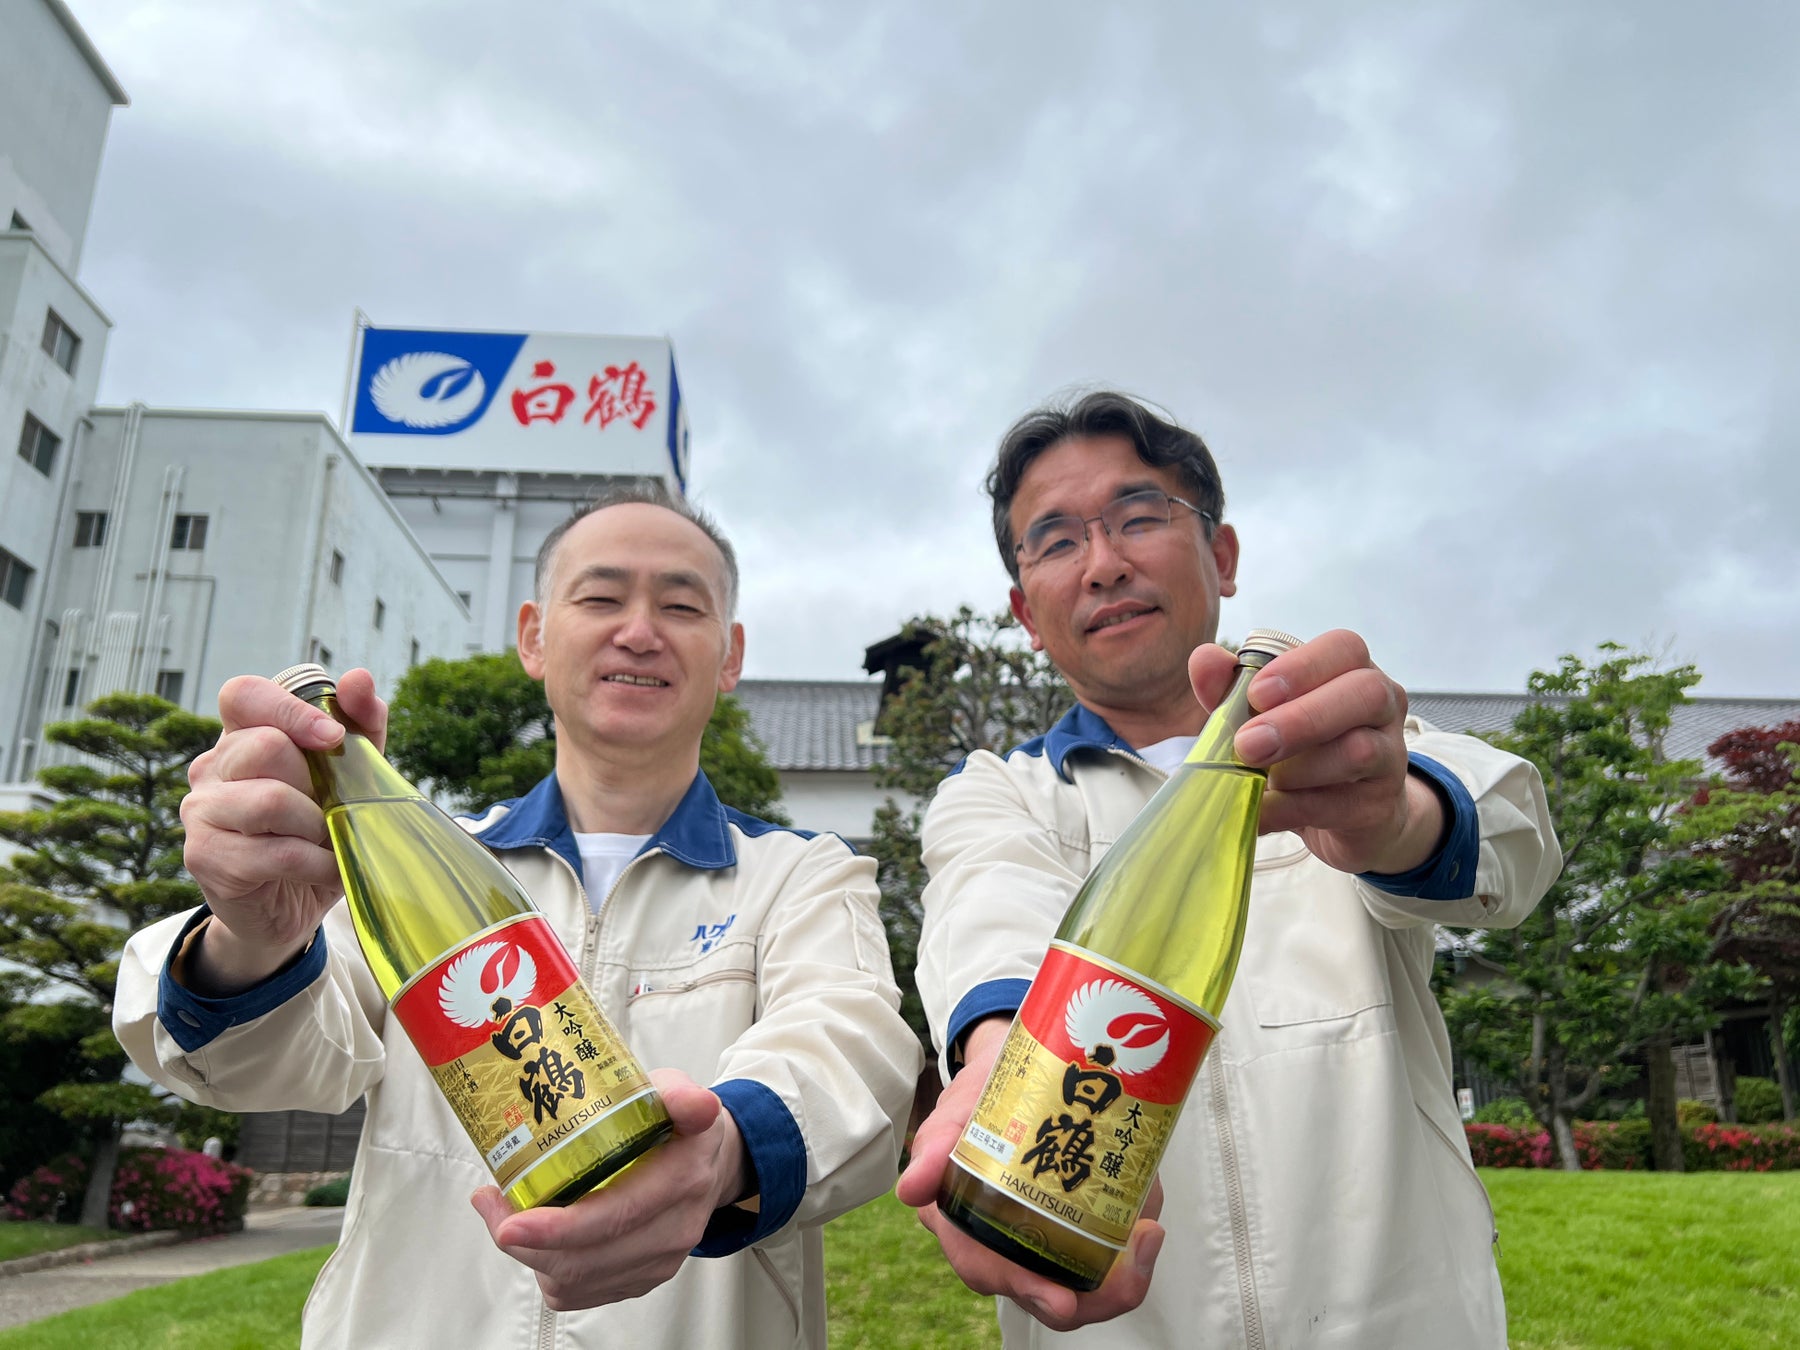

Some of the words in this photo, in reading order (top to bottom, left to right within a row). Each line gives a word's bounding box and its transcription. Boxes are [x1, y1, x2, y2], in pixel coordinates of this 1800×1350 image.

[511, 360, 656, 430] 白鶴
[491, 996, 585, 1125] 白鶴
[553, 1002, 600, 1062] 大吟醸
[1014, 1040, 1038, 1080] 日本酒
[455, 1059, 479, 1094] 日本酒
[536, 1094, 613, 1152] HAKUTSURU
[1020, 1045, 1122, 1193] 白鶴
[1099, 1101, 1143, 1180] 大吟醸
[1000, 1171, 1084, 1225] HAKUTSURU
